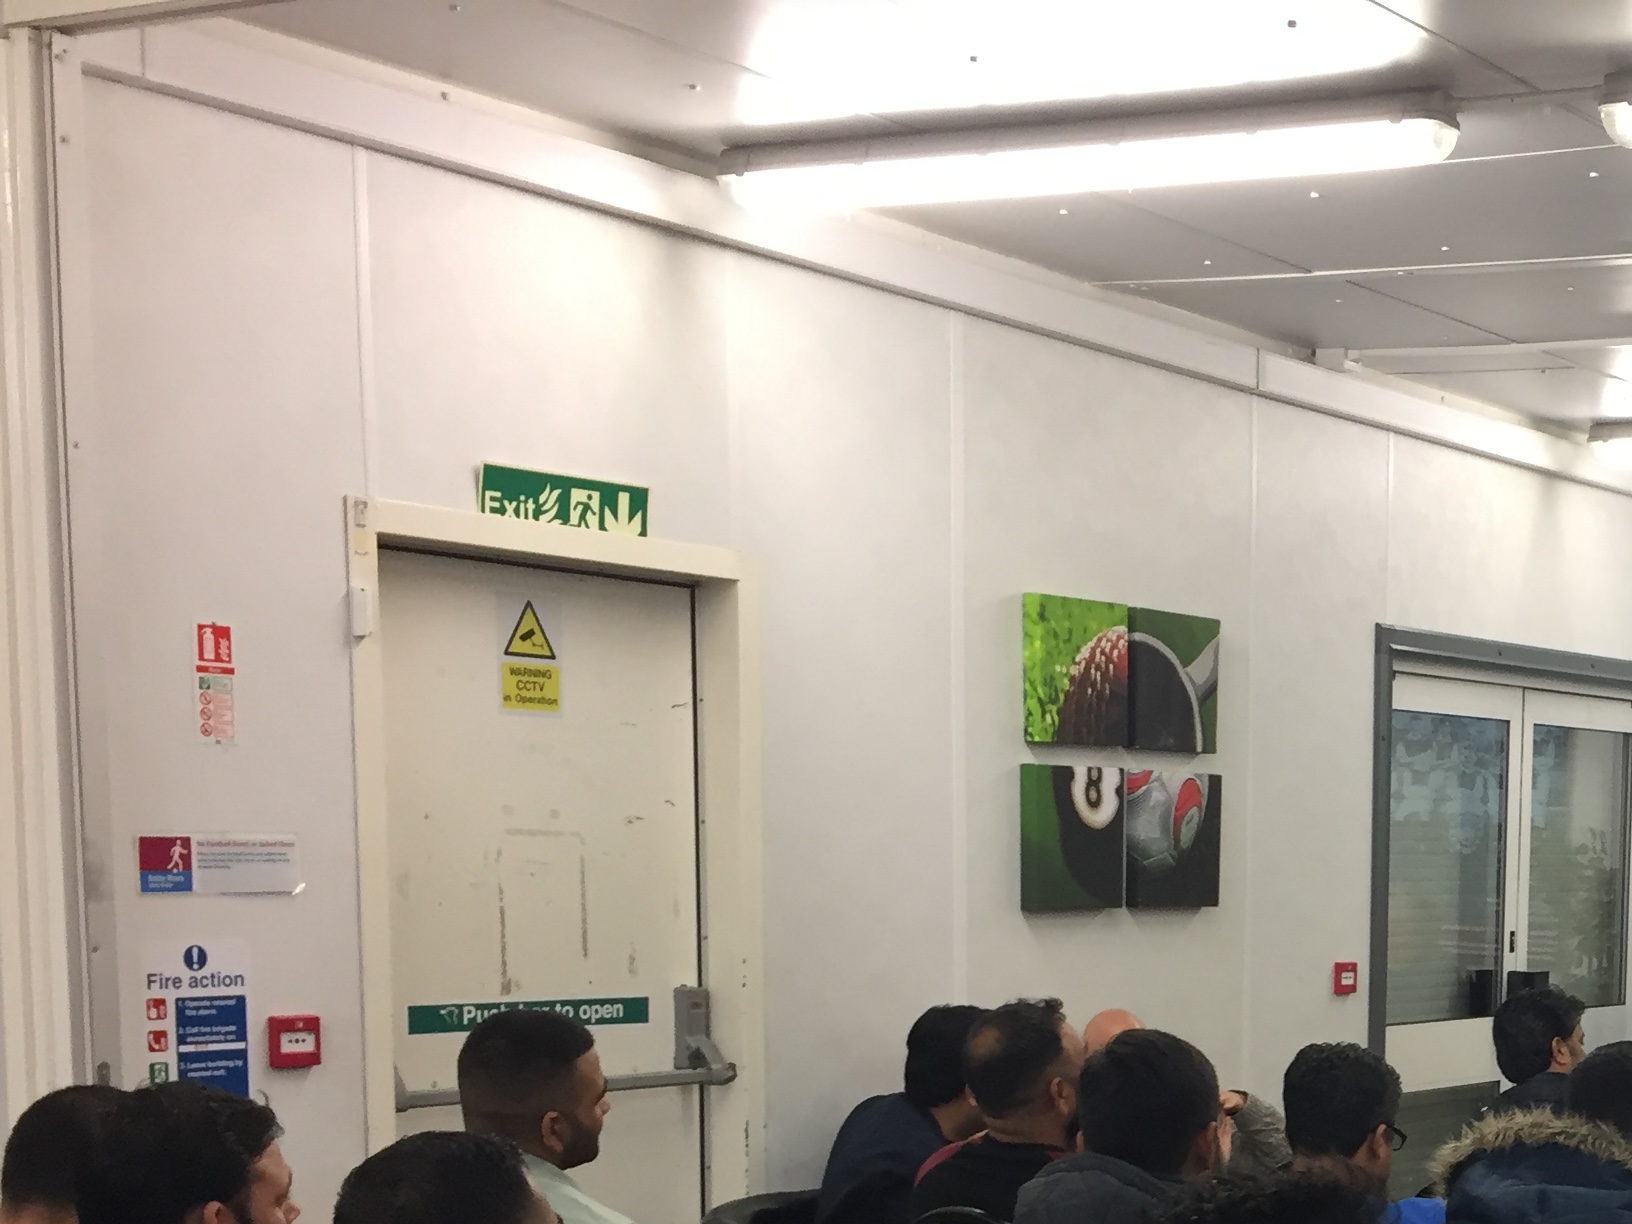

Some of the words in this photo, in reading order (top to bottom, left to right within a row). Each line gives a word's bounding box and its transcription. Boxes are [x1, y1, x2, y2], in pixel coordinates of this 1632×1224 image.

[485, 490, 535, 520] Exit
[509, 667, 552, 680] WARNING
[516, 680, 546, 692] CCTV
[515, 693, 558, 706] Operation
[146, 973, 183, 990] Fire
[188, 971, 245, 988] action
[579, 1003, 624, 1023] open
